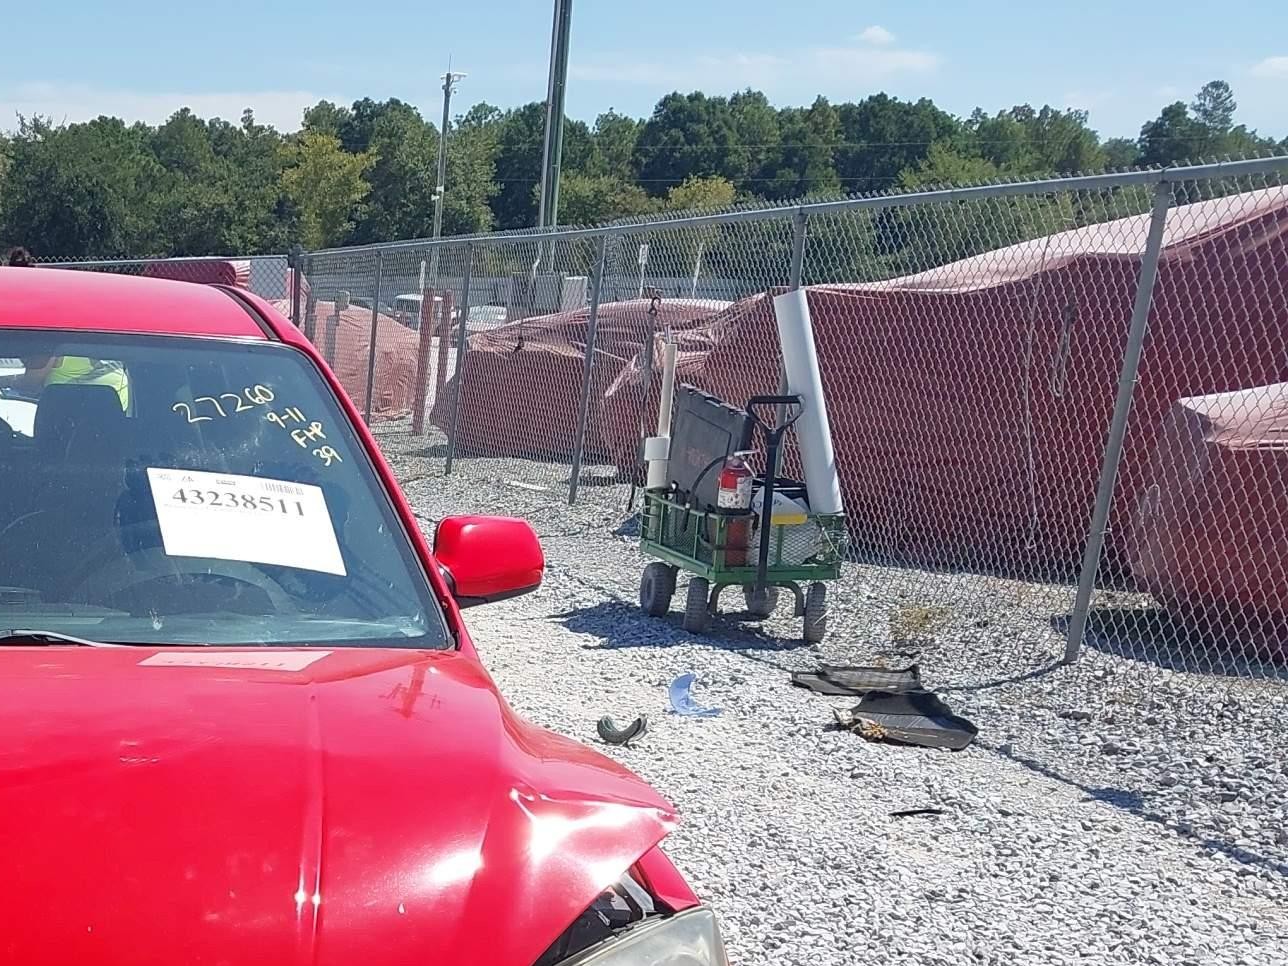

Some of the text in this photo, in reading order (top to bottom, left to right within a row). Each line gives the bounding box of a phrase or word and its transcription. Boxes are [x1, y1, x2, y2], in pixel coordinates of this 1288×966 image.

[172, 384, 275, 423] 27260
[266, 407, 306, 428] 9-11
[172, 487, 305, 516] 43238511
